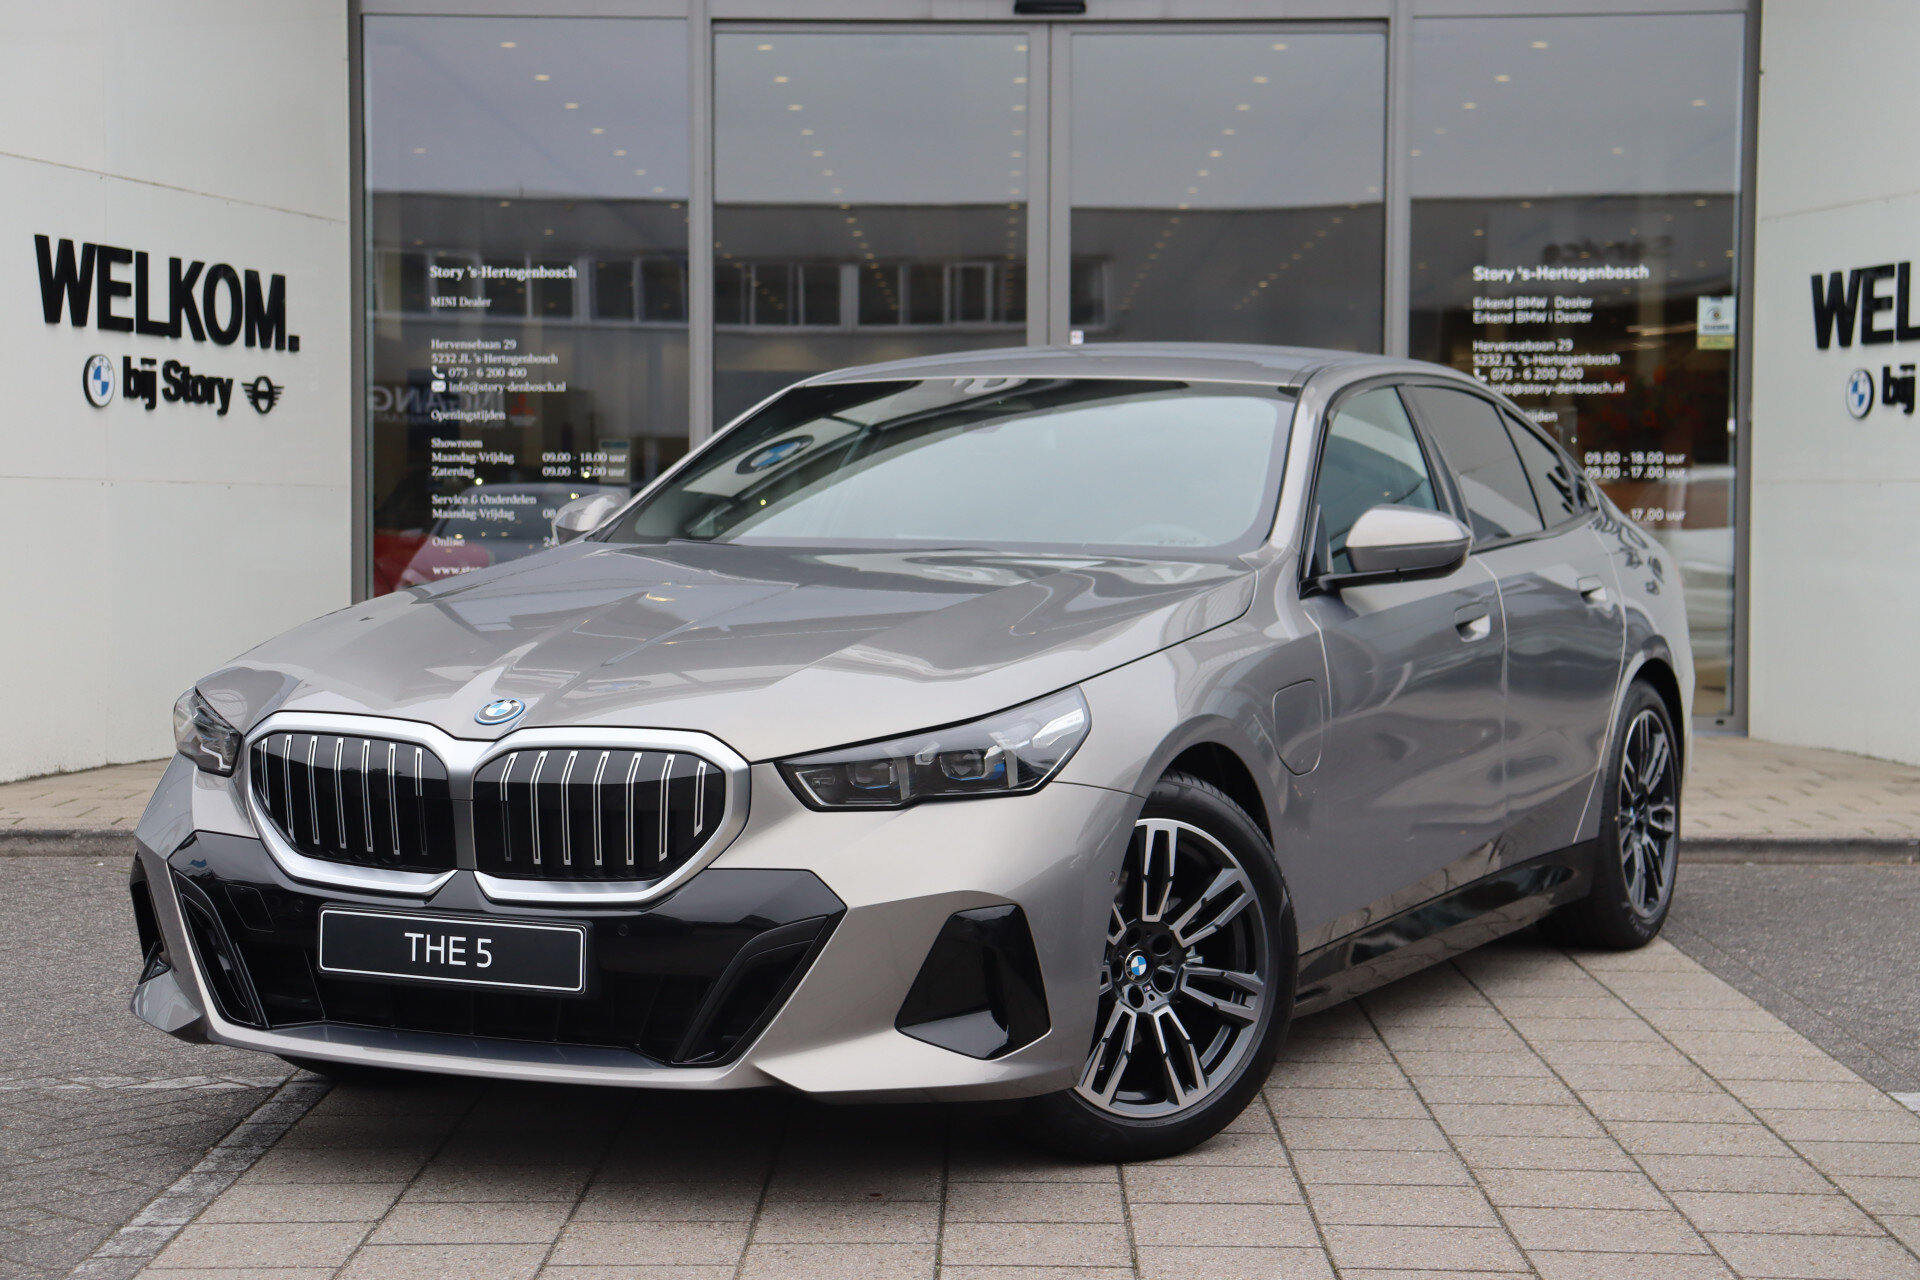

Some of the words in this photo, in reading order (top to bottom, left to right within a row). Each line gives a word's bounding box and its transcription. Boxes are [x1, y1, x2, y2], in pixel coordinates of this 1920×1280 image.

[430, 265, 465, 281] Story
[467, 264, 577, 281] 's-Hertogenbosch
[1473, 266, 1515, 283] Story
[1517, 264, 1649, 282] 's-Hertogenbosch
[34, 234, 300, 352] WELKOM.
[430, 297, 457, 308] MINI
[459, 296, 492, 308] Dealer
[1473, 296, 1513, 309] Erkend
[1515, 296, 1548, 309] BMW
[1554, 296, 1593, 309] Dealer
[1473, 311, 1513, 324] Erkend
[1515, 311, 1547, 324] BMW
[1554, 311, 1593, 324] Dealer
[503, 339, 516, 350] 29
[1557, 339, 1573, 351] 29
[431, 353, 457, 364] 5232
[458, 353, 472, 364] JL
[1473, 354, 1502, 366] 5232
[1503, 354, 1516, 367] JL
[448, 368, 468, 378] 073
[476, 368, 484, 378] 6
[486, 368, 505, 378] 200
[507, 368, 527, 378] 400
[1490, 368, 1513, 380] 073
[1523, 368, 1532, 380] 6
[1533, 368, 1557, 380] 200
[1558, 368, 1584, 380] 400
[122, 356, 157, 411] bij
[162, 360, 233, 415] Story
[1881, 364, 1916, 415] bij
[431, 410, 506, 424] Openingstijden
[431, 438, 483, 449] Showroom
[542, 452, 571, 463] 09.00
[580, 452, 607, 463] 18.00
[608, 454, 627, 463] uur
[1585, 452, 1621, 465] 09.00
[1630, 452, 1664, 465] 18.00
[1665, 454, 1687, 464] uur
[431, 466, 475, 479] Zaterdag
[542, 466, 571, 477] 09.00
[608, 468, 626, 477] uur
[1585, 466, 1621, 479] 09.00
[1630, 466, 1664, 479] 17.00
[1665, 468, 1687, 479] uur
[431, 495, 467, 505] Service
[480, 494, 537, 505] Onderdelen
[1630, 509, 1664, 521] 17.00
[1665, 511, 1687, 521] uur
[432, 536, 465, 547] Online
[404, 932, 467, 966] THE
[476, 938, 492, 968] 5
